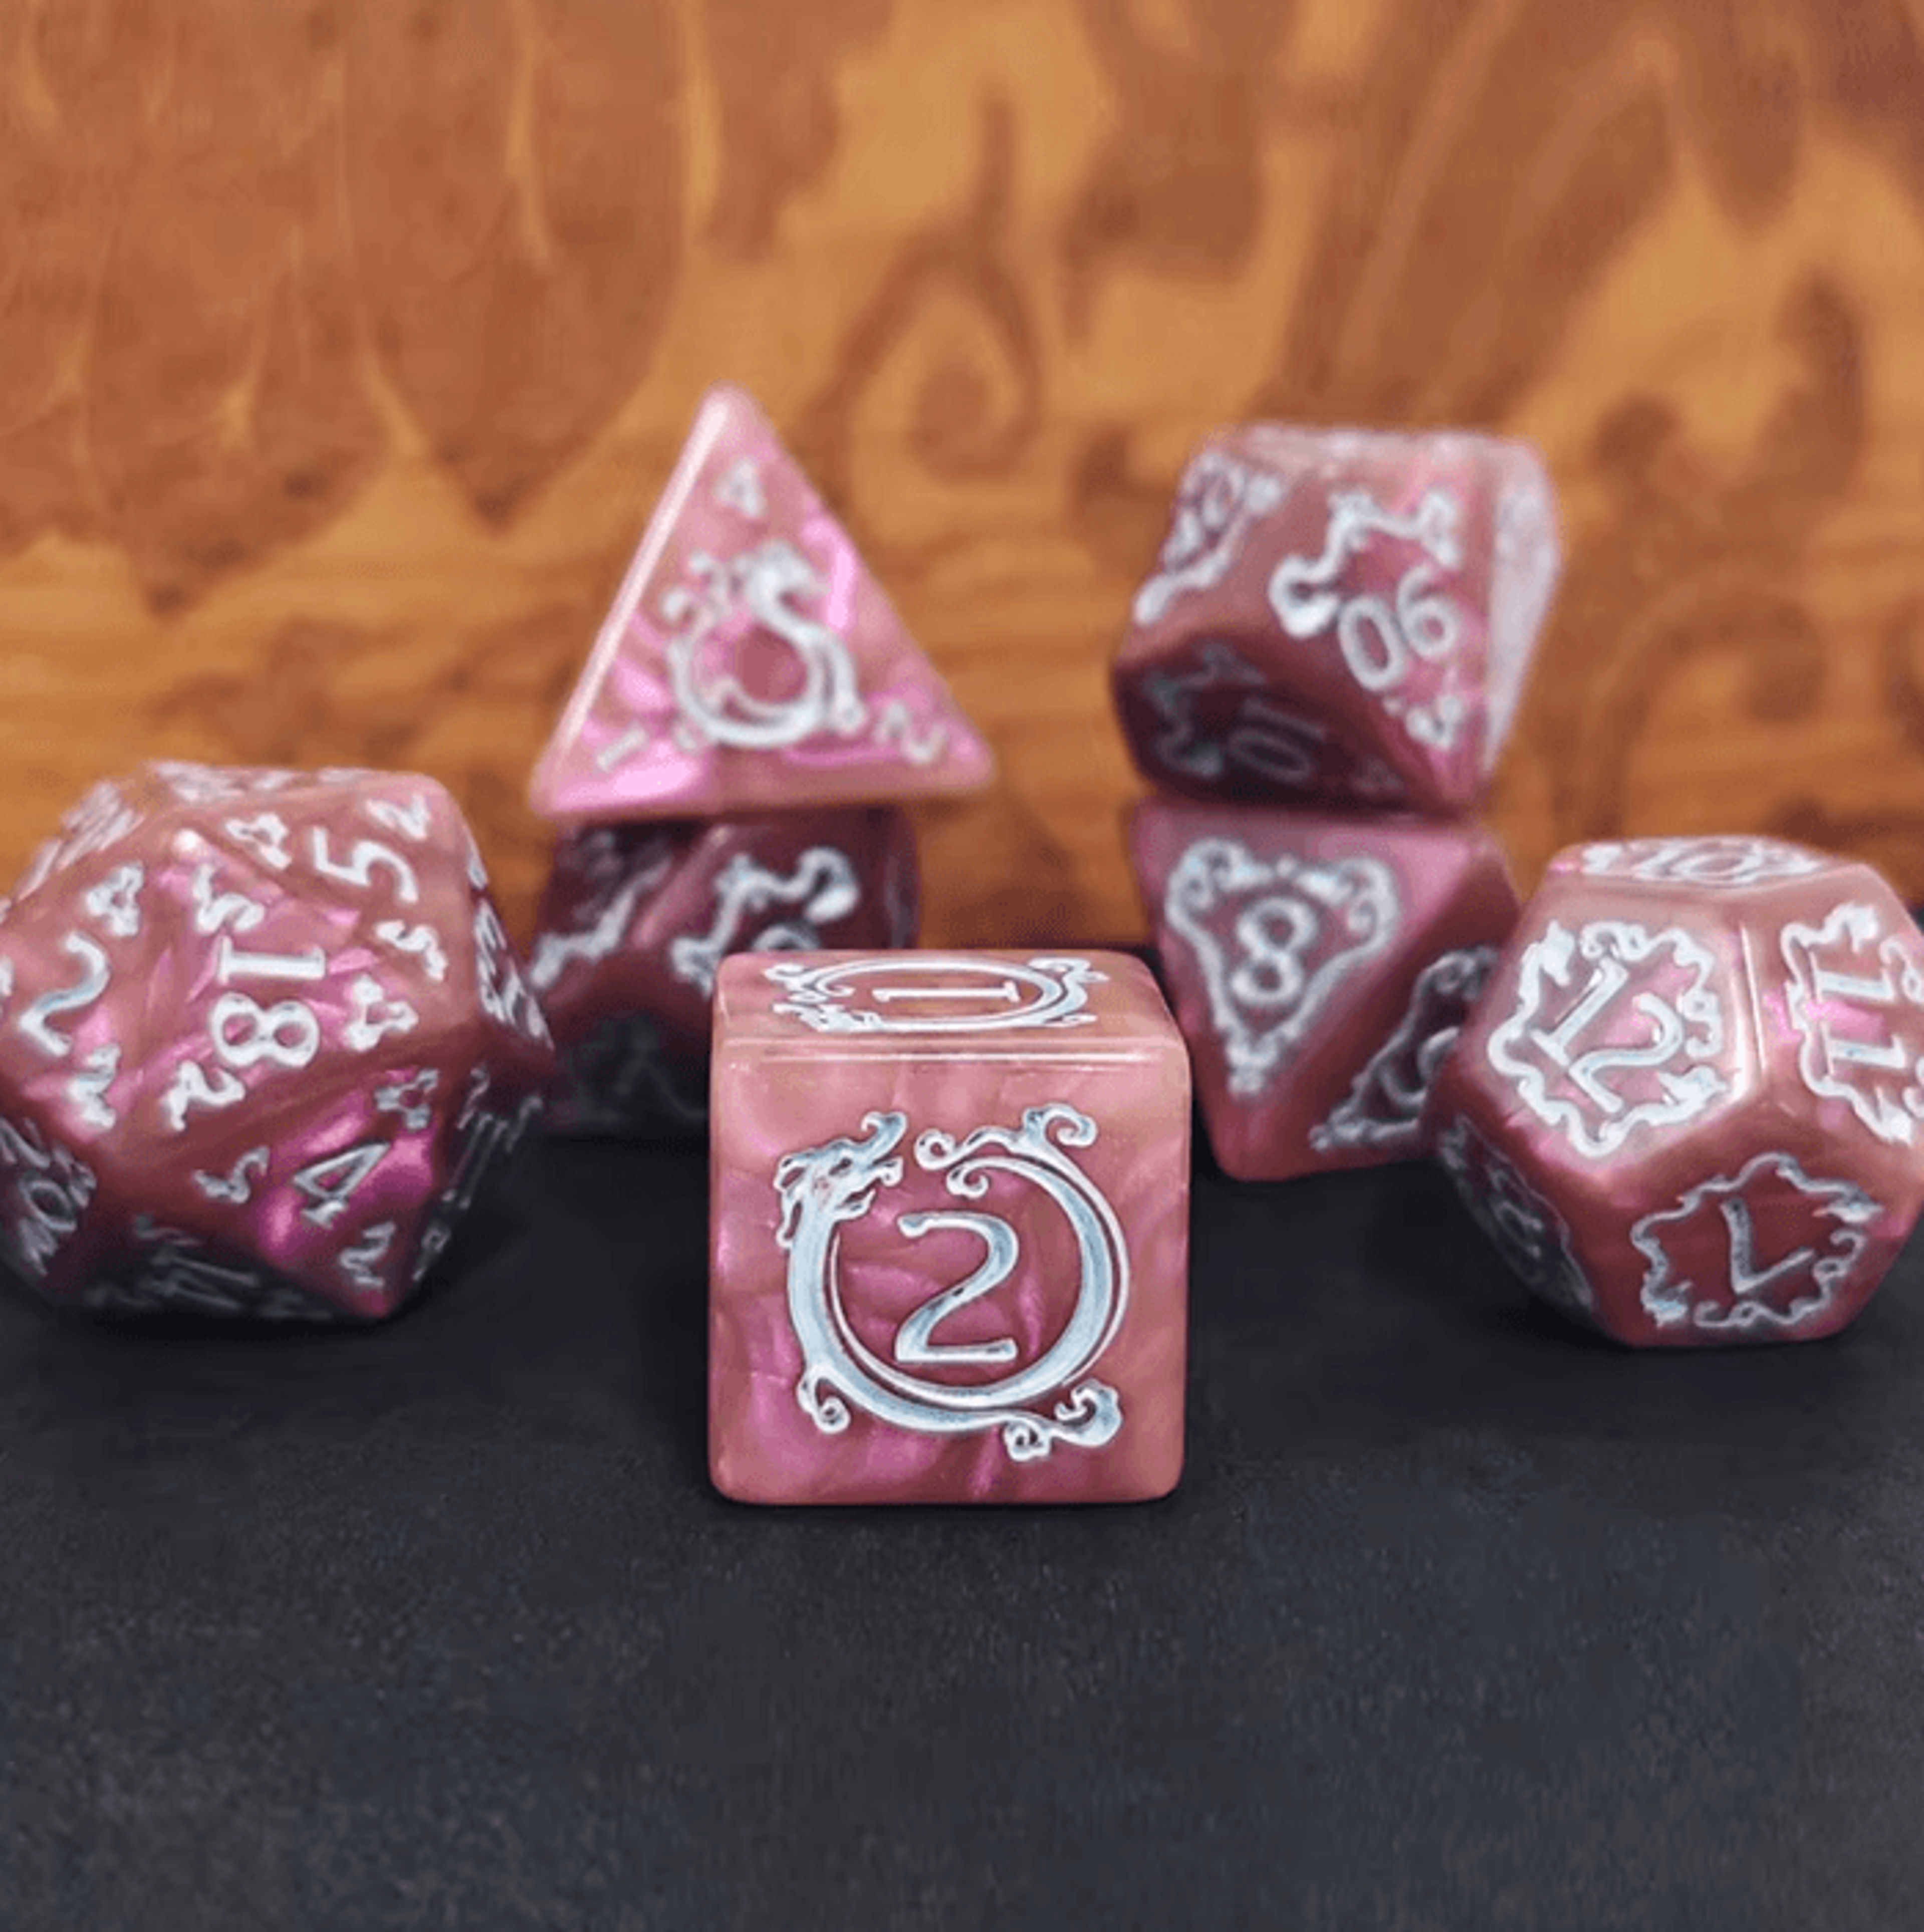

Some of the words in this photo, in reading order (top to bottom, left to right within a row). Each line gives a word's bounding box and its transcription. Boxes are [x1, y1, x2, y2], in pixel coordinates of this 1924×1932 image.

[18, 931, 109, 1056] 2
[210, 936, 327, 1067] 18
[872, 982, 1020, 1002] 1
[1230, 899, 1318, 1005] 8
[1808, 952, 1906, 1075] 11
[1531, 958, 1682, 1114] 12
[293, 1142, 391, 1227] 4
[896, 1212, 1019, 1362] 2
